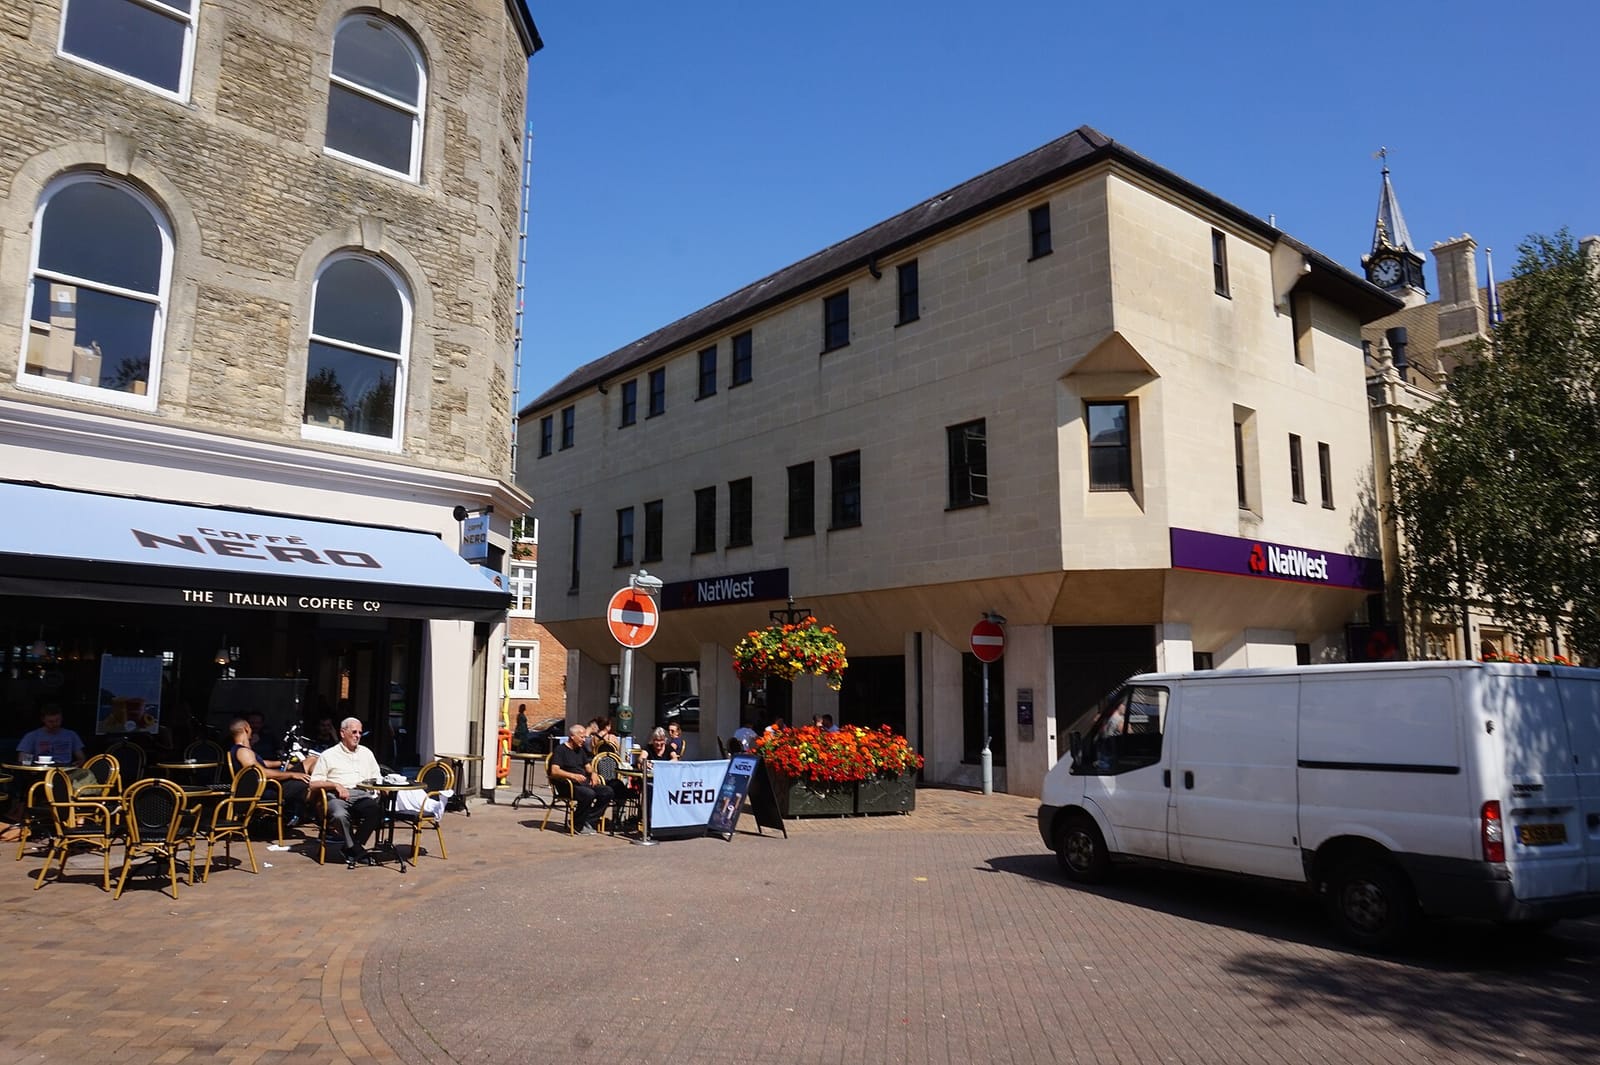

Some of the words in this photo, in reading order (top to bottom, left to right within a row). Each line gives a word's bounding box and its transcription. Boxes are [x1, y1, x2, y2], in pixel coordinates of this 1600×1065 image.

[130, 528, 384, 569] NERO
[464, 533, 486, 544] NERO
[1267, 545, 1329, 580] NatWest
[182, 589, 214, 603] THE
[228, 592, 288, 607] ITALIAN
[298, 596, 354, 610] COFFEE
[697, 576, 755, 602] NatWest
[668, 789, 715, 806] NERO
